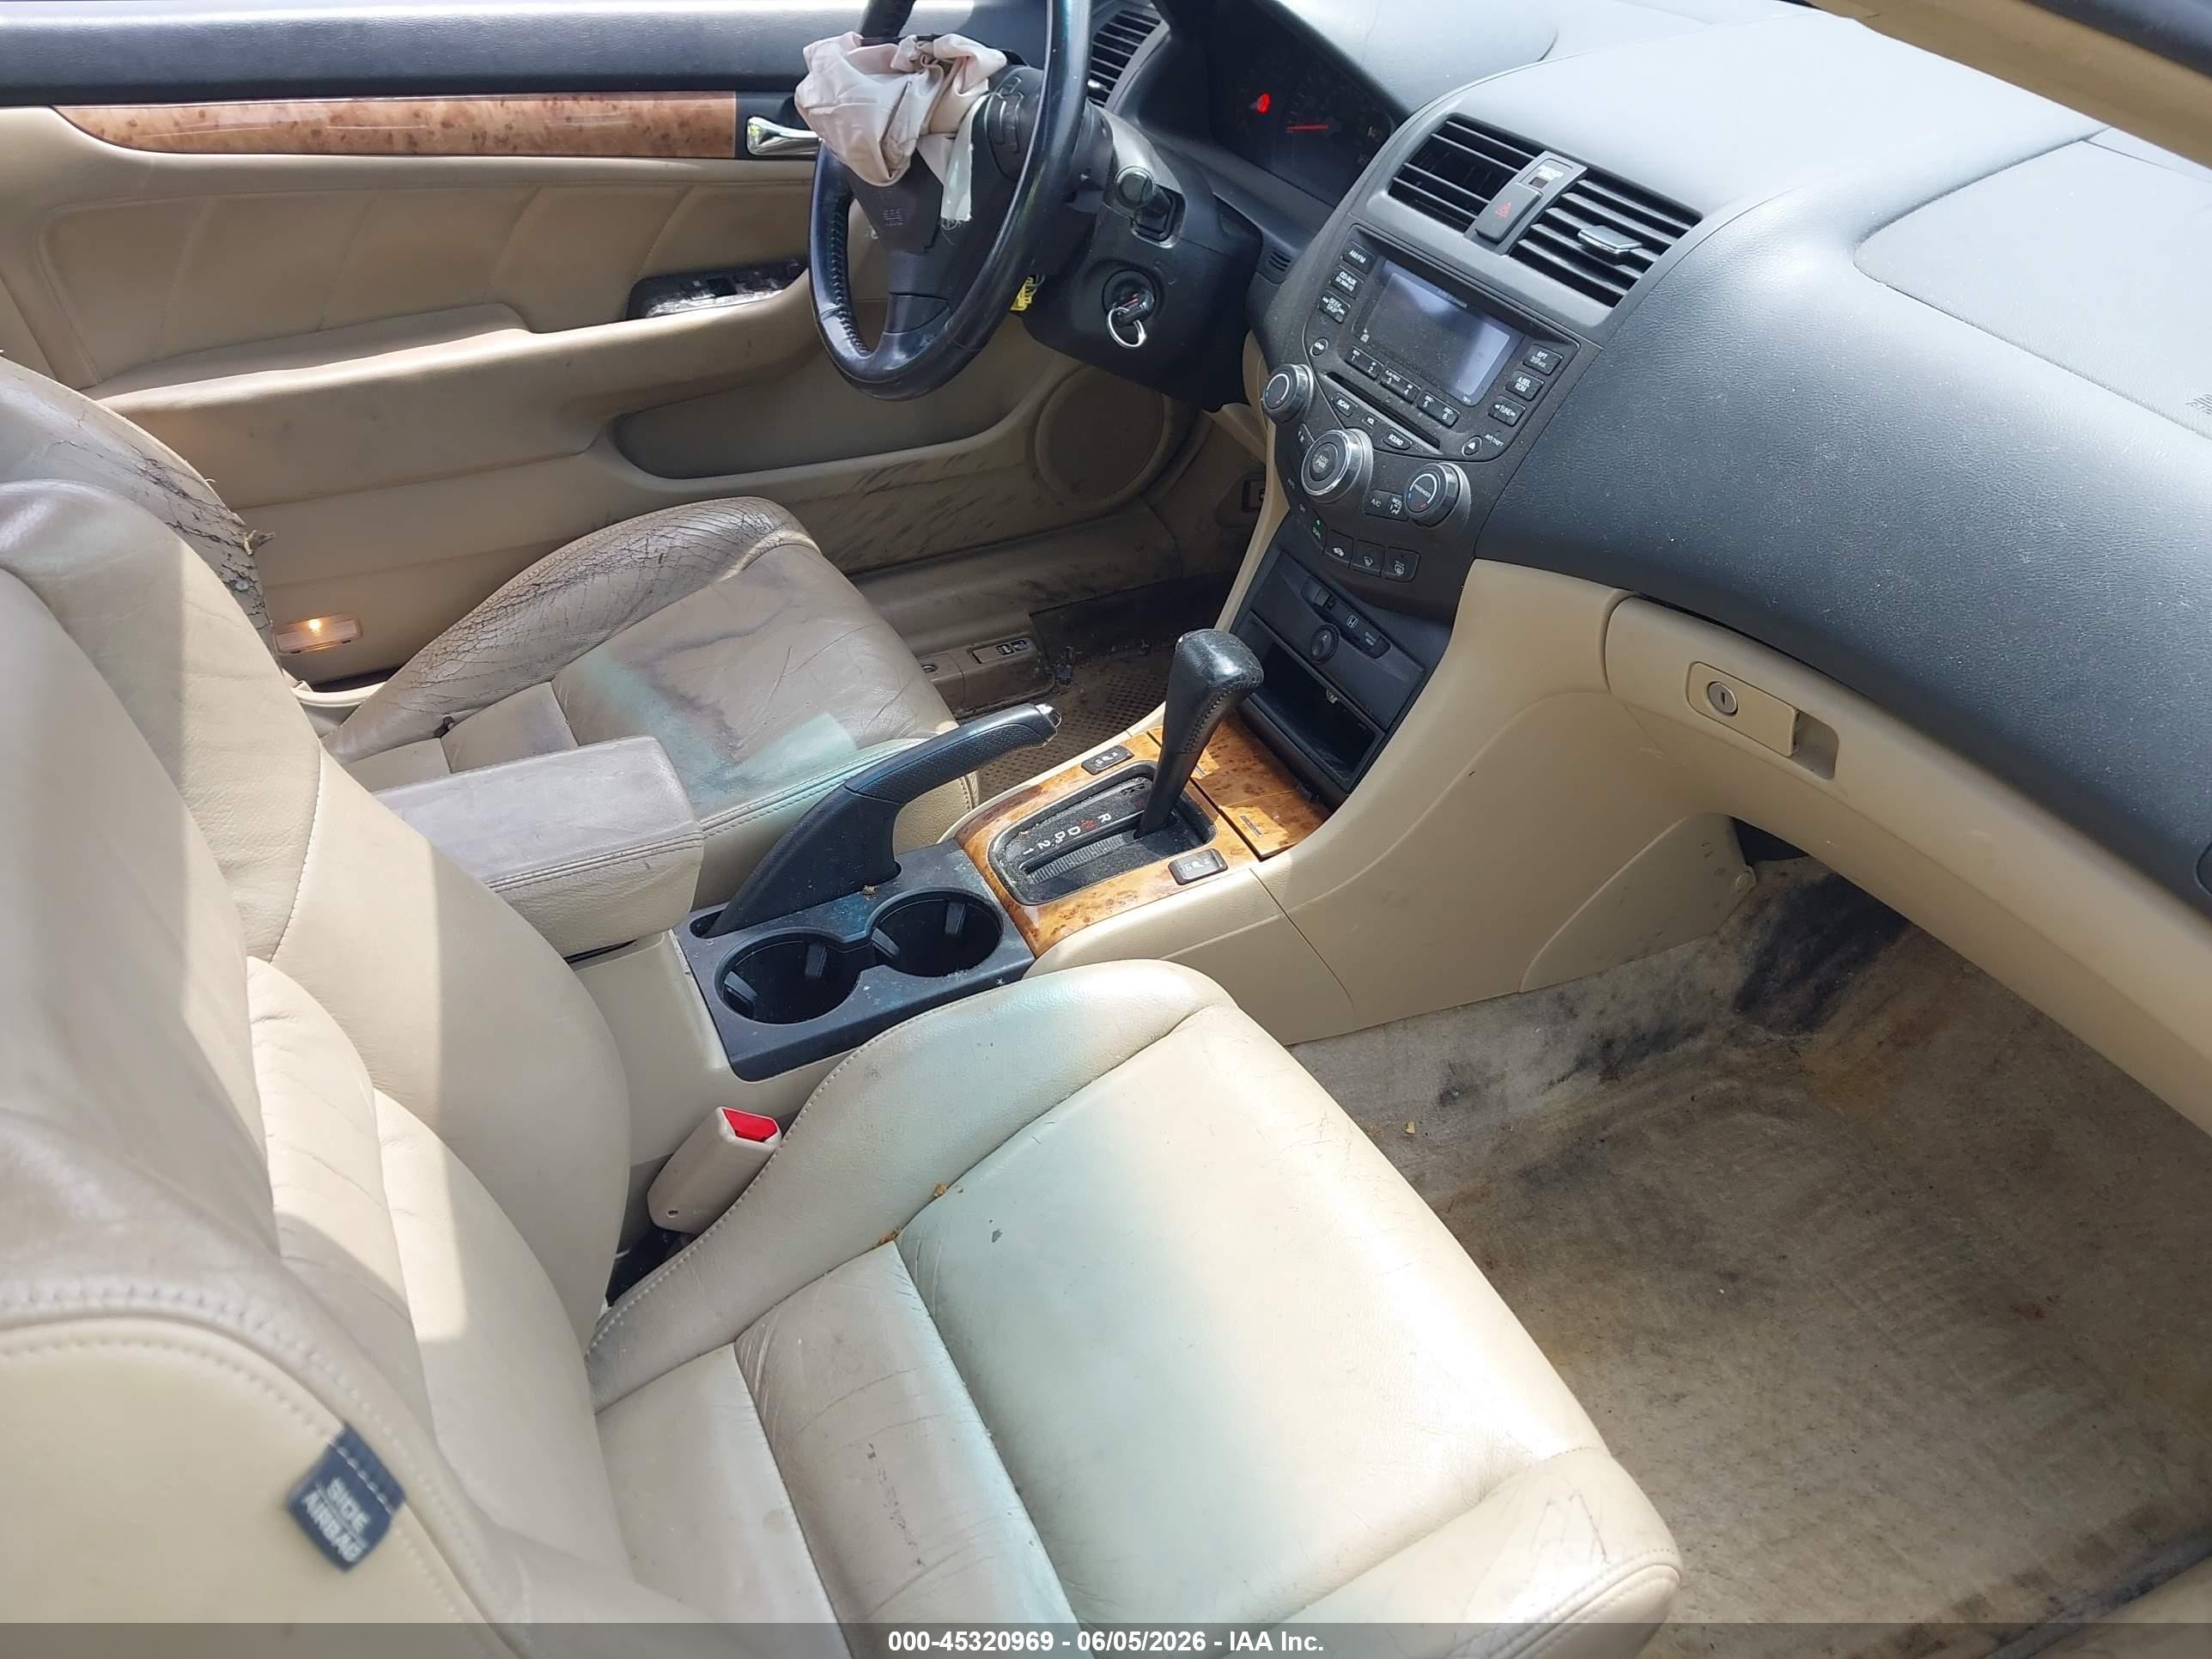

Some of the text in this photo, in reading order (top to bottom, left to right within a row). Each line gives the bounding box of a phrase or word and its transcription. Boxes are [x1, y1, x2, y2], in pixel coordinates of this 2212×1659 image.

[1336, 398, 1350, 410] SCAN
[1499, 404, 1512, 416] TUNE
[1388, 434, 1404, 447] SOUND
[1098, 812, 1112, 823] R
[1067, 825, 1081, 836] D
[1037, 840, 1051, 849] 2
[327, 1476, 370, 1533] SIDE
